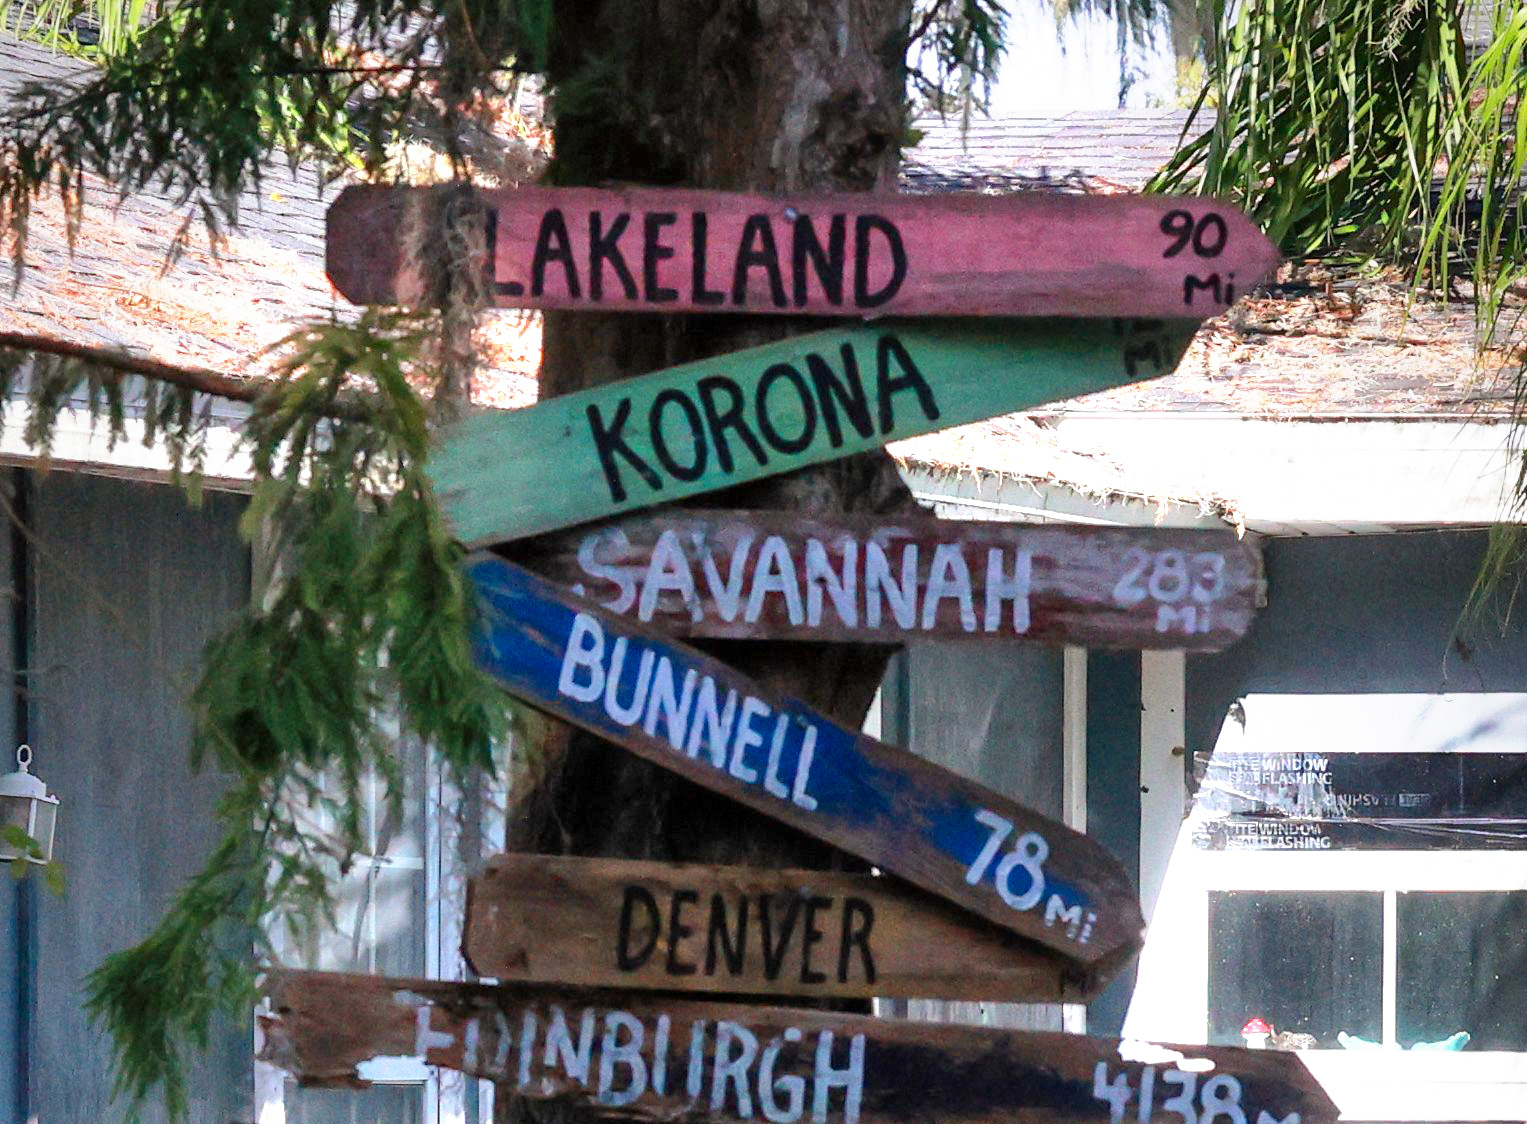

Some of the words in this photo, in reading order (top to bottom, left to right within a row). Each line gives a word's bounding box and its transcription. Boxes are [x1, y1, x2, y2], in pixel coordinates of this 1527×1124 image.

[485, 207, 908, 308] LAKELAND
[1160, 209, 1227, 258] 90
[1183, 272, 1235, 306] Mi
[585, 334, 940, 502] KORONA
[575, 525, 1033, 634] SAVANNAH
[1113, 547, 1226, 607] 283
[558, 612, 818, 811] BUNNELL
[1262, 758, 1329, 771] WINDOW
[1262, 771, 1333, 785] FLASHING
[965, 809, 1049, 911] 78
[1044, 893, 1097, 944] Mi
[1260, 836, 1331, 849] FLASHING
[616, 884, 876, 984] DENVER
